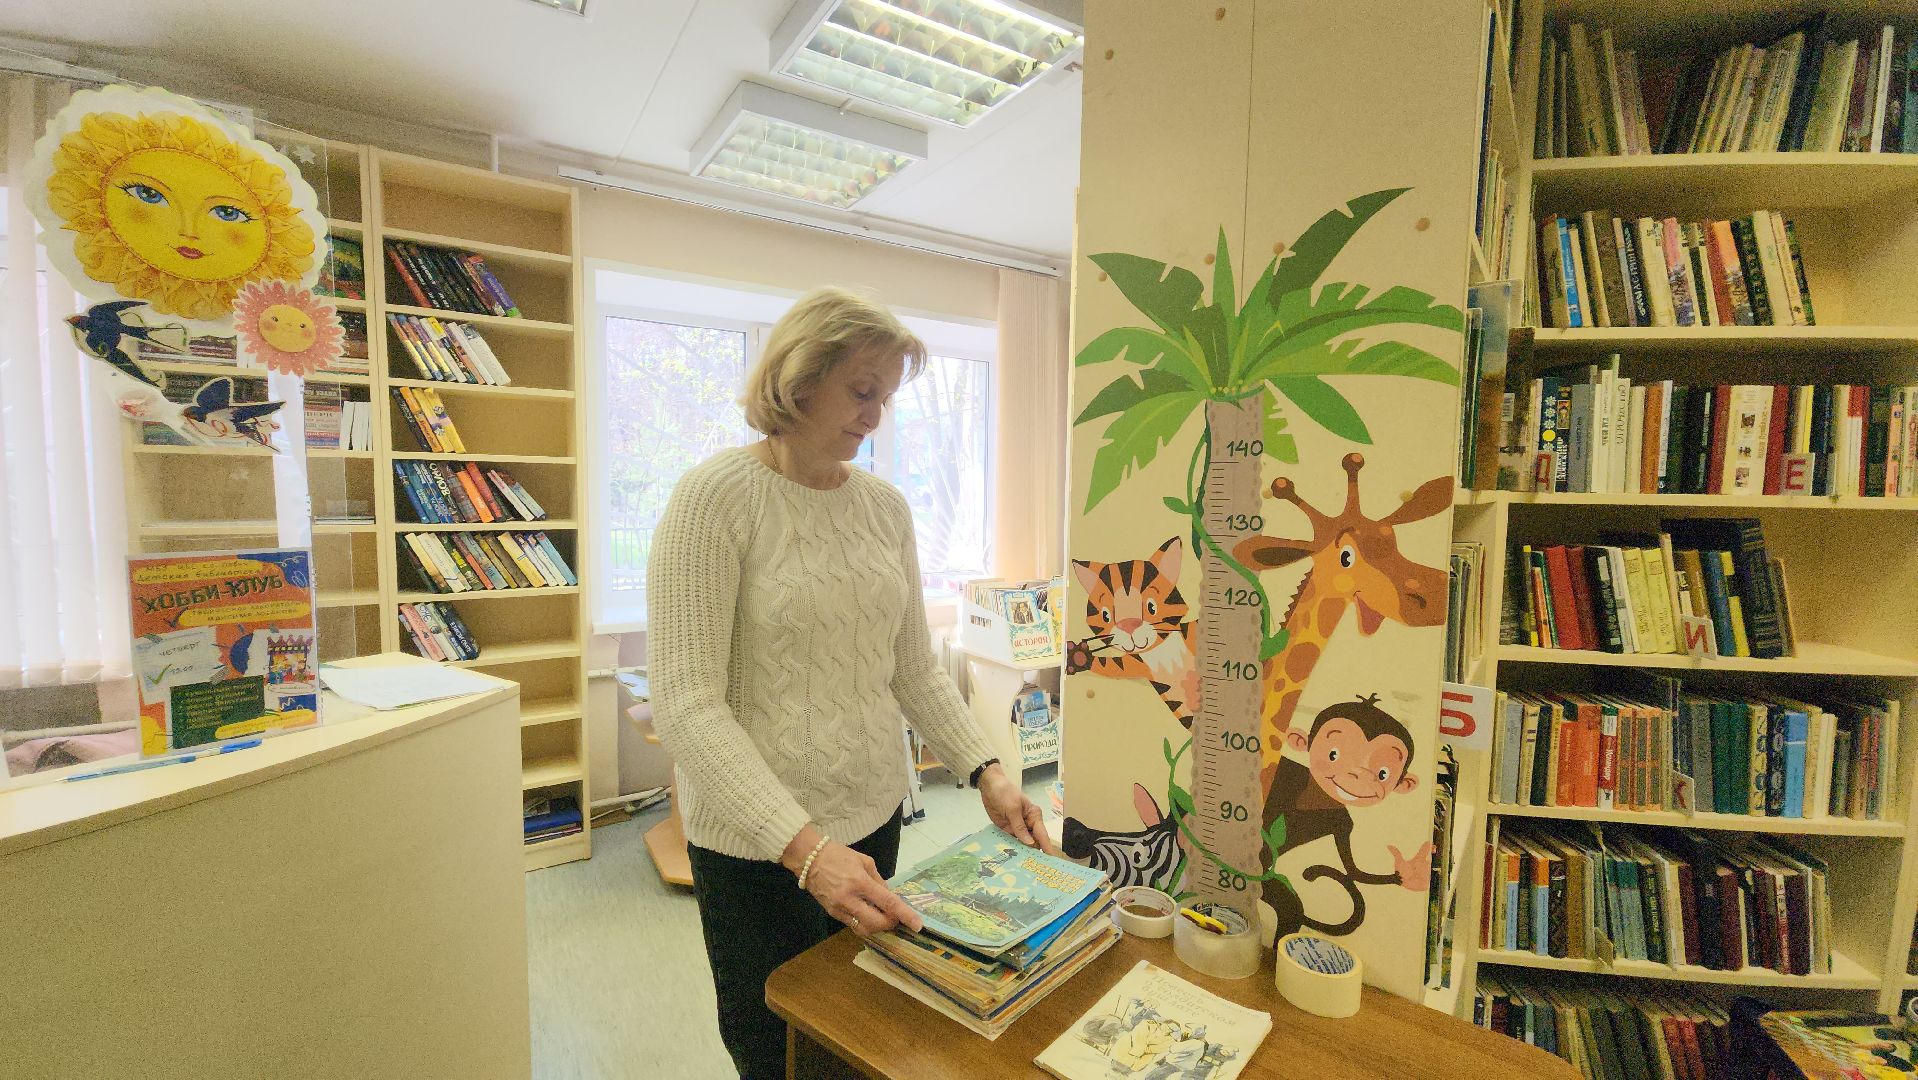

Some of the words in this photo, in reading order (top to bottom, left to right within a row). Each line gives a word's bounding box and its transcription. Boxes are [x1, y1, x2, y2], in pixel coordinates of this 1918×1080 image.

[1226, 439, 1264, 457] 140
[1785, 458, 1806, 490] Е
[1225, 514, 1264, 532] 130
[140, 574, 283, 614] ХОББИ-КЛУБ
[1224, 587, 1262, 608] 120
[1014, 635, 1049, 648] ИСТОРИЯ
[1684, 621, 1709, 654] И
[1222, 659, 1258, 681] 110
[1220, 730, 1261, 753] 100
[1220, 800, 1248, 822] 90
[1218, 869, 1247, 892] 80
